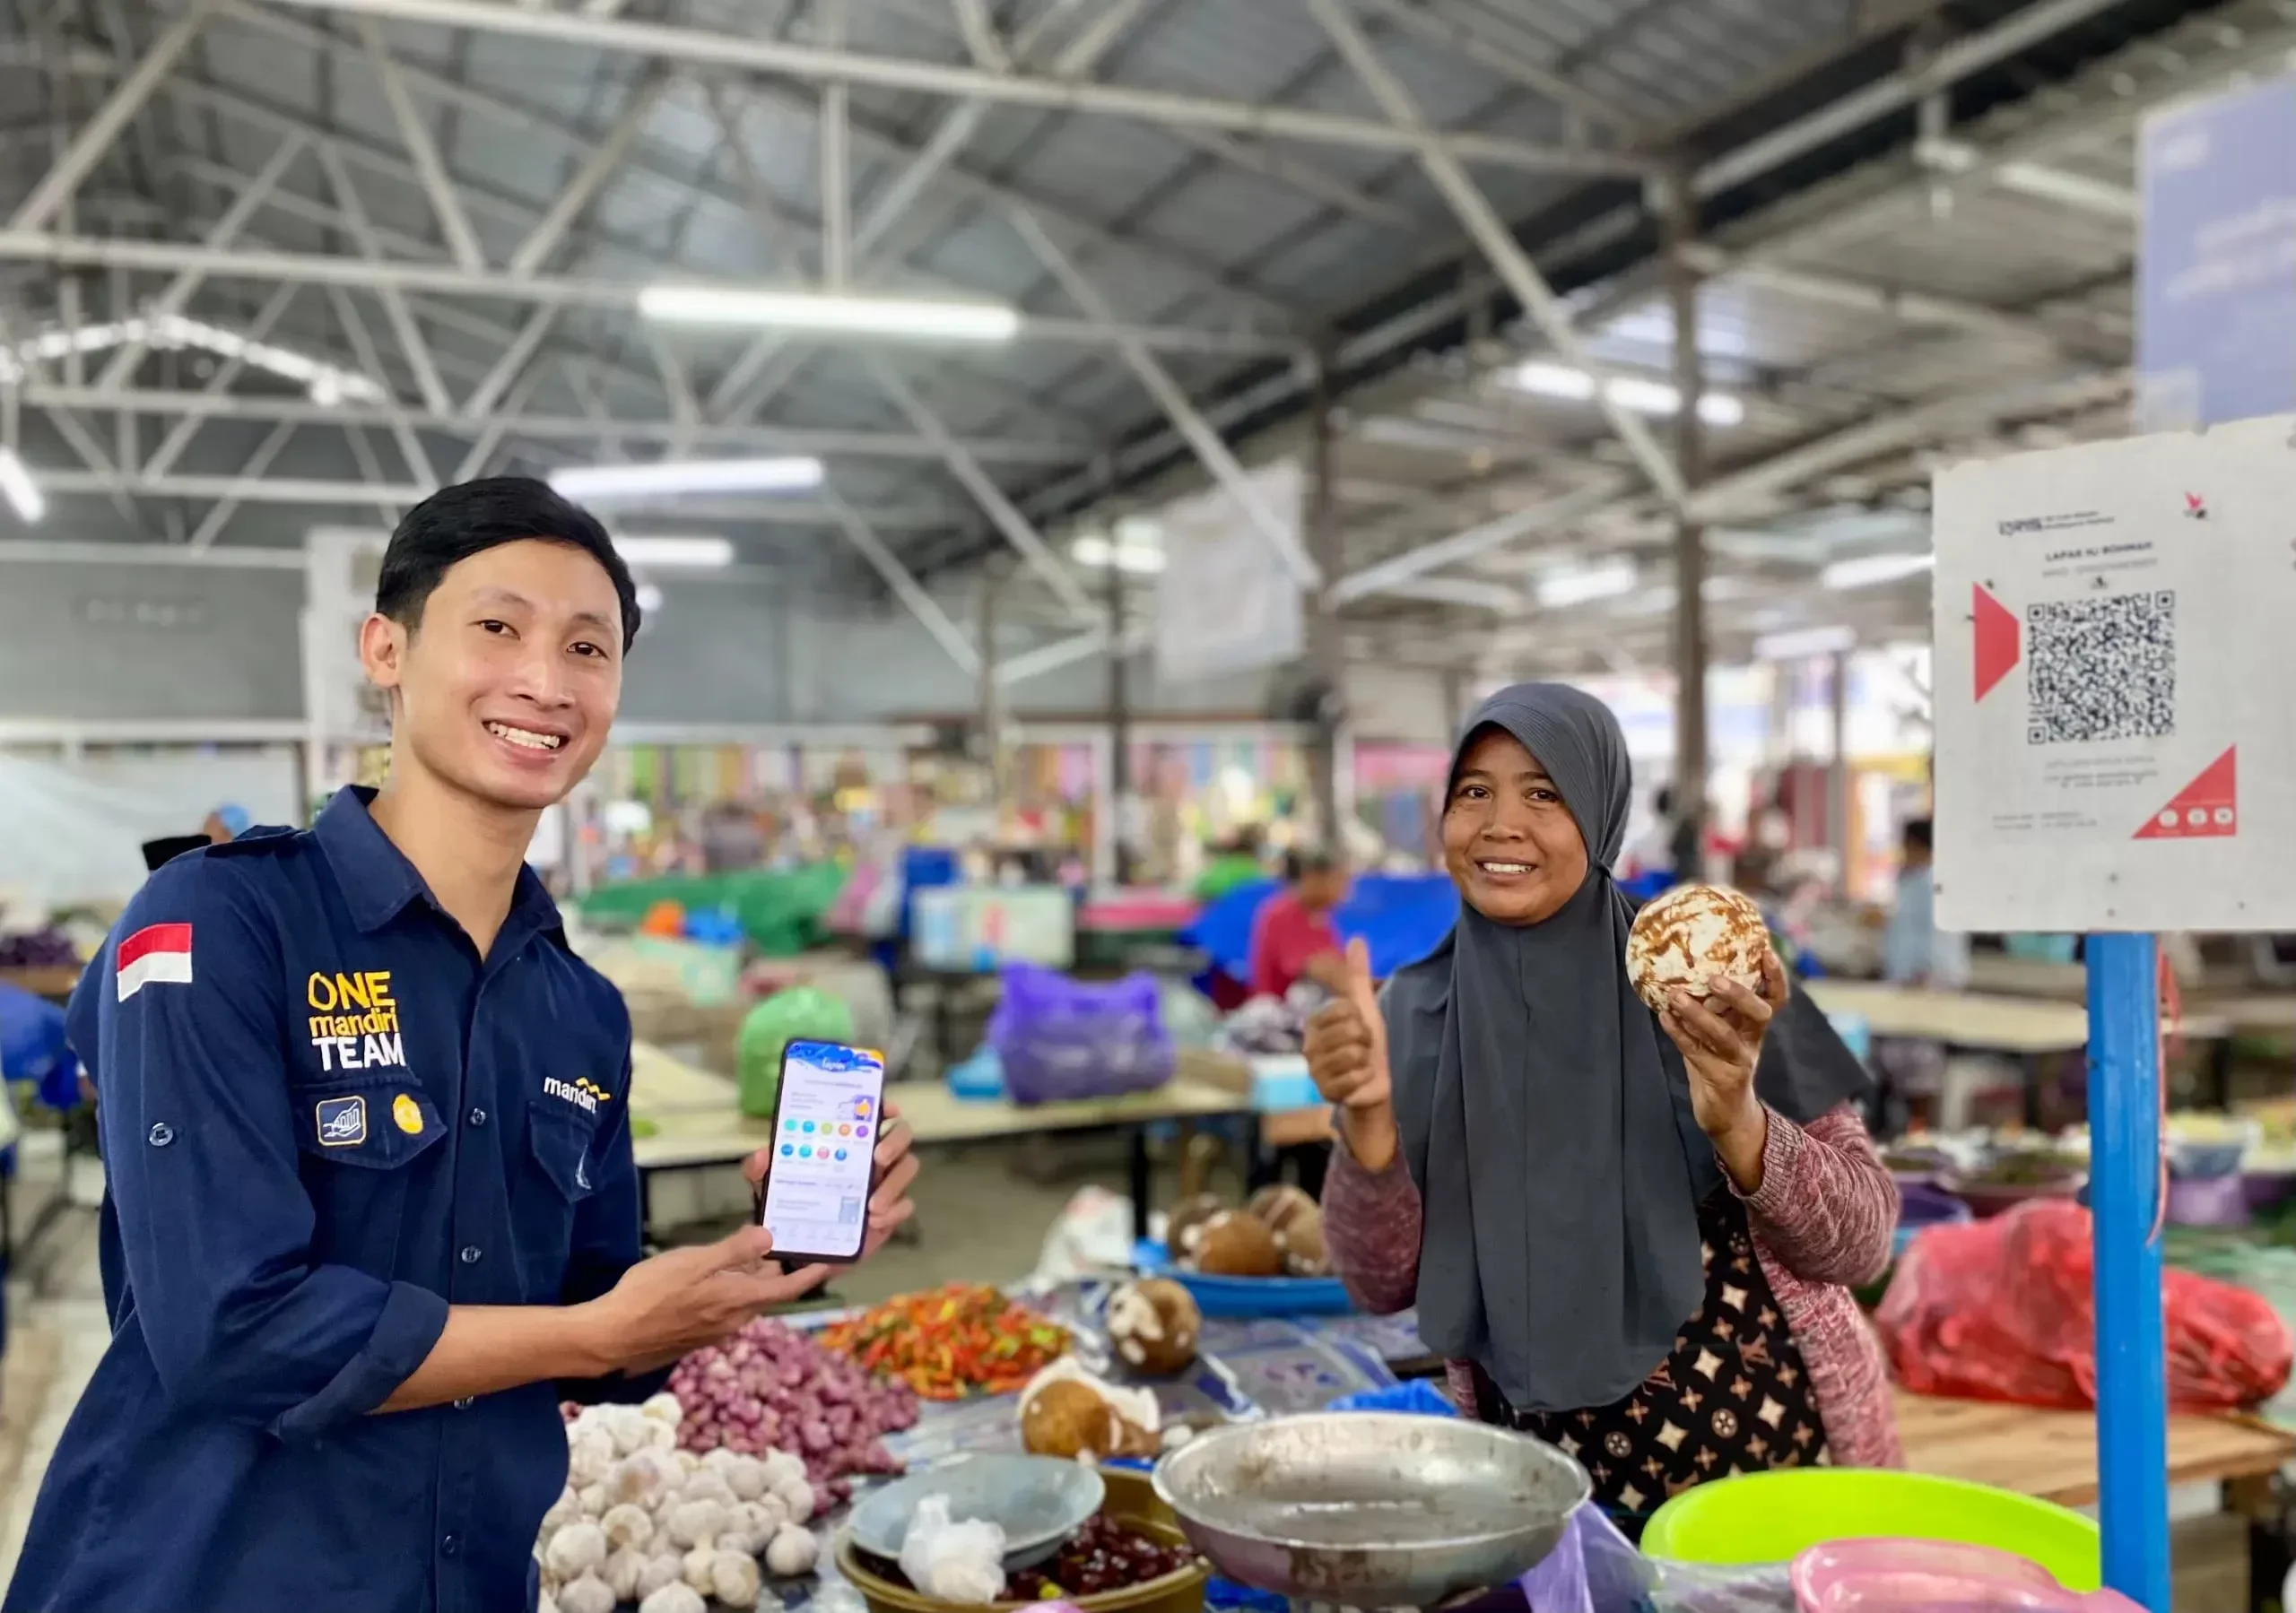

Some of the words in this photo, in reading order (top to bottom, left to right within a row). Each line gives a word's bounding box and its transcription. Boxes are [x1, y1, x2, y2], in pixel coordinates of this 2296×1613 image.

[308, 971, 396, 1011] ONE
[309, 1006, 400, 1037] mandiri
[311, 1032, 407, 1071] TEAM
